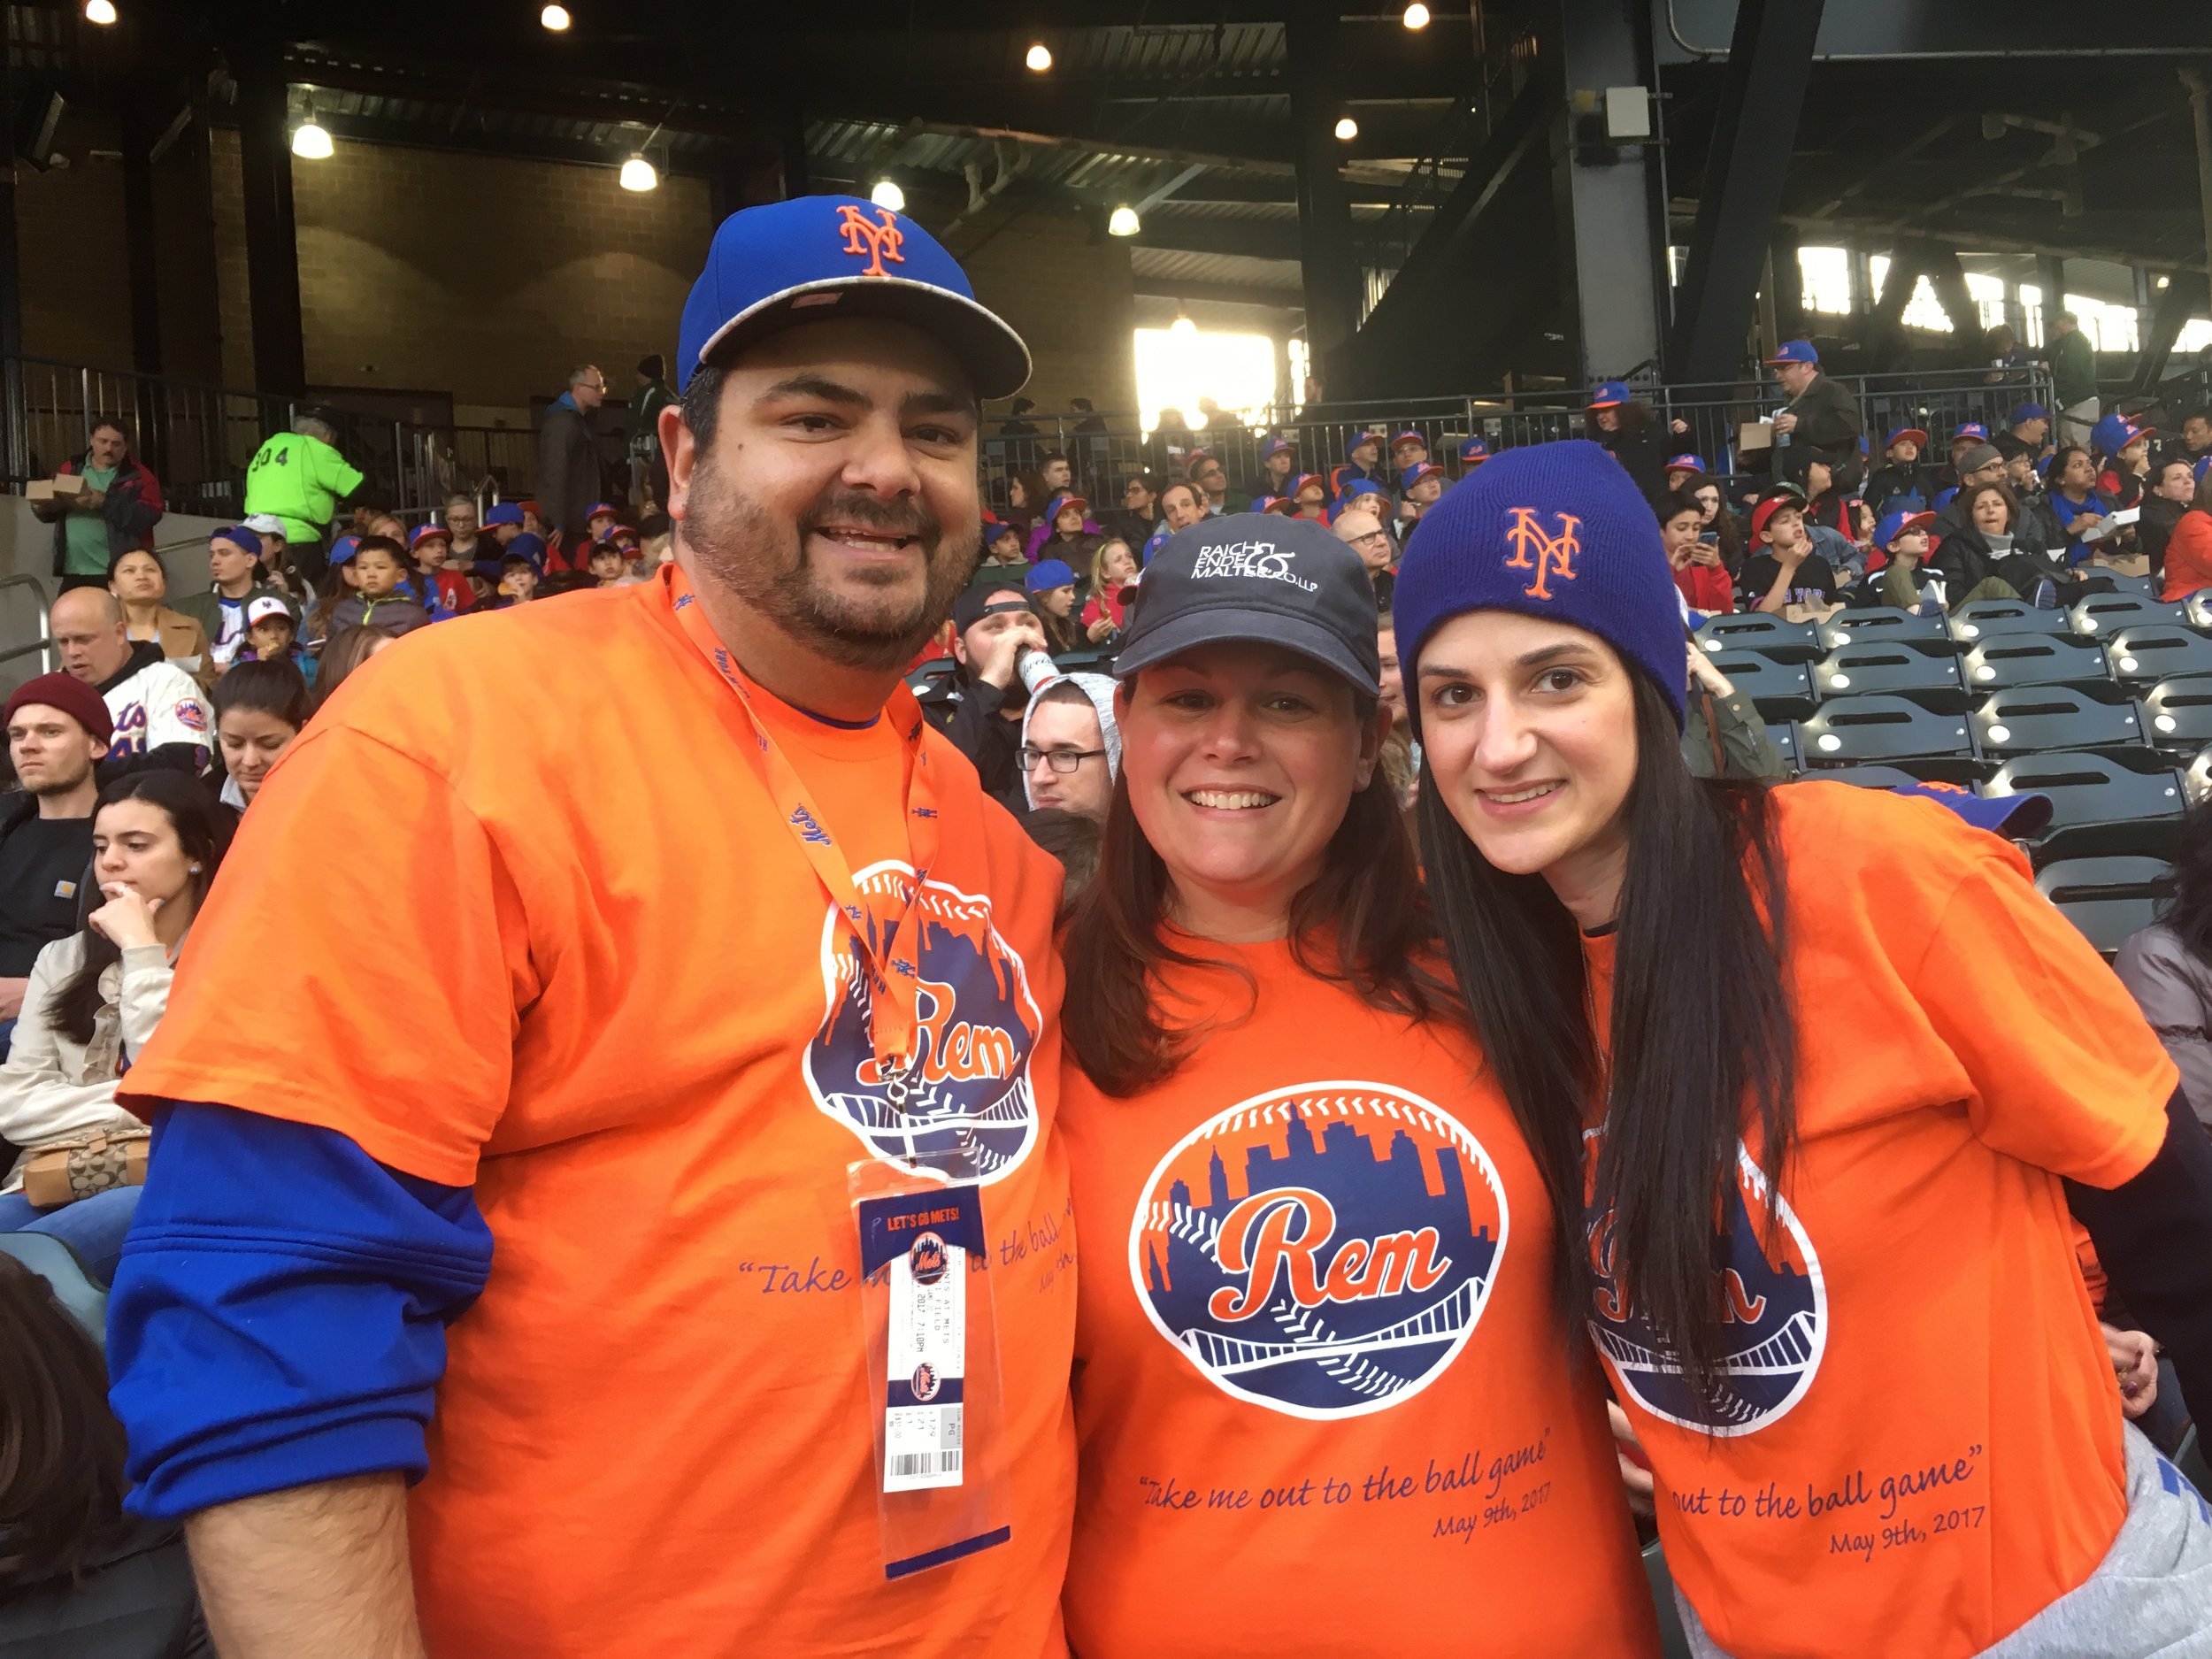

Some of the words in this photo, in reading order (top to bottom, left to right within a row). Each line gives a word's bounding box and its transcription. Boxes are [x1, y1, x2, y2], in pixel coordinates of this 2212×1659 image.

[836, 205, 905, 277] NY
[1505, 506, 1582, 601] NY
[856, 975, 1022, 1086] Rem
[887, 1212, 917, 1232] LET'S
[918, 1212, 930, 1227] GO
[930, 1206, 960, 1225] METS!
[1027, 1211, 1062, 1252] ball
[1208, 1187, 1453, 1322] Rem
[917, 1294, 926, 1313] 2017
[948, 1422, 956, 1436] PG
[1208, 1489, 1253, 1509] me
[1260, 1479, 1317, 1509] out
[1321, 1476, 1351, 1506] to
[1363, 1465, 1418, 1502] the
[1424, 1450, 1485, 1494] ball
[1718, 1487, 1747, 1517] to
[1755, 1481, 1802, 1519] the
[1808, 1470, 1873, 1517] ball
[1432, 1517, 1479, 1545] May
[1483, 1497, 1517, 1527] 9th,
[1521, 1481, 1552, 1514] 2017
[1829, 1532, 1875, 1563] May
[1882, 1518, 1927, 1551] 9th,
[1933, 1505, 1986, 1534] 2017
